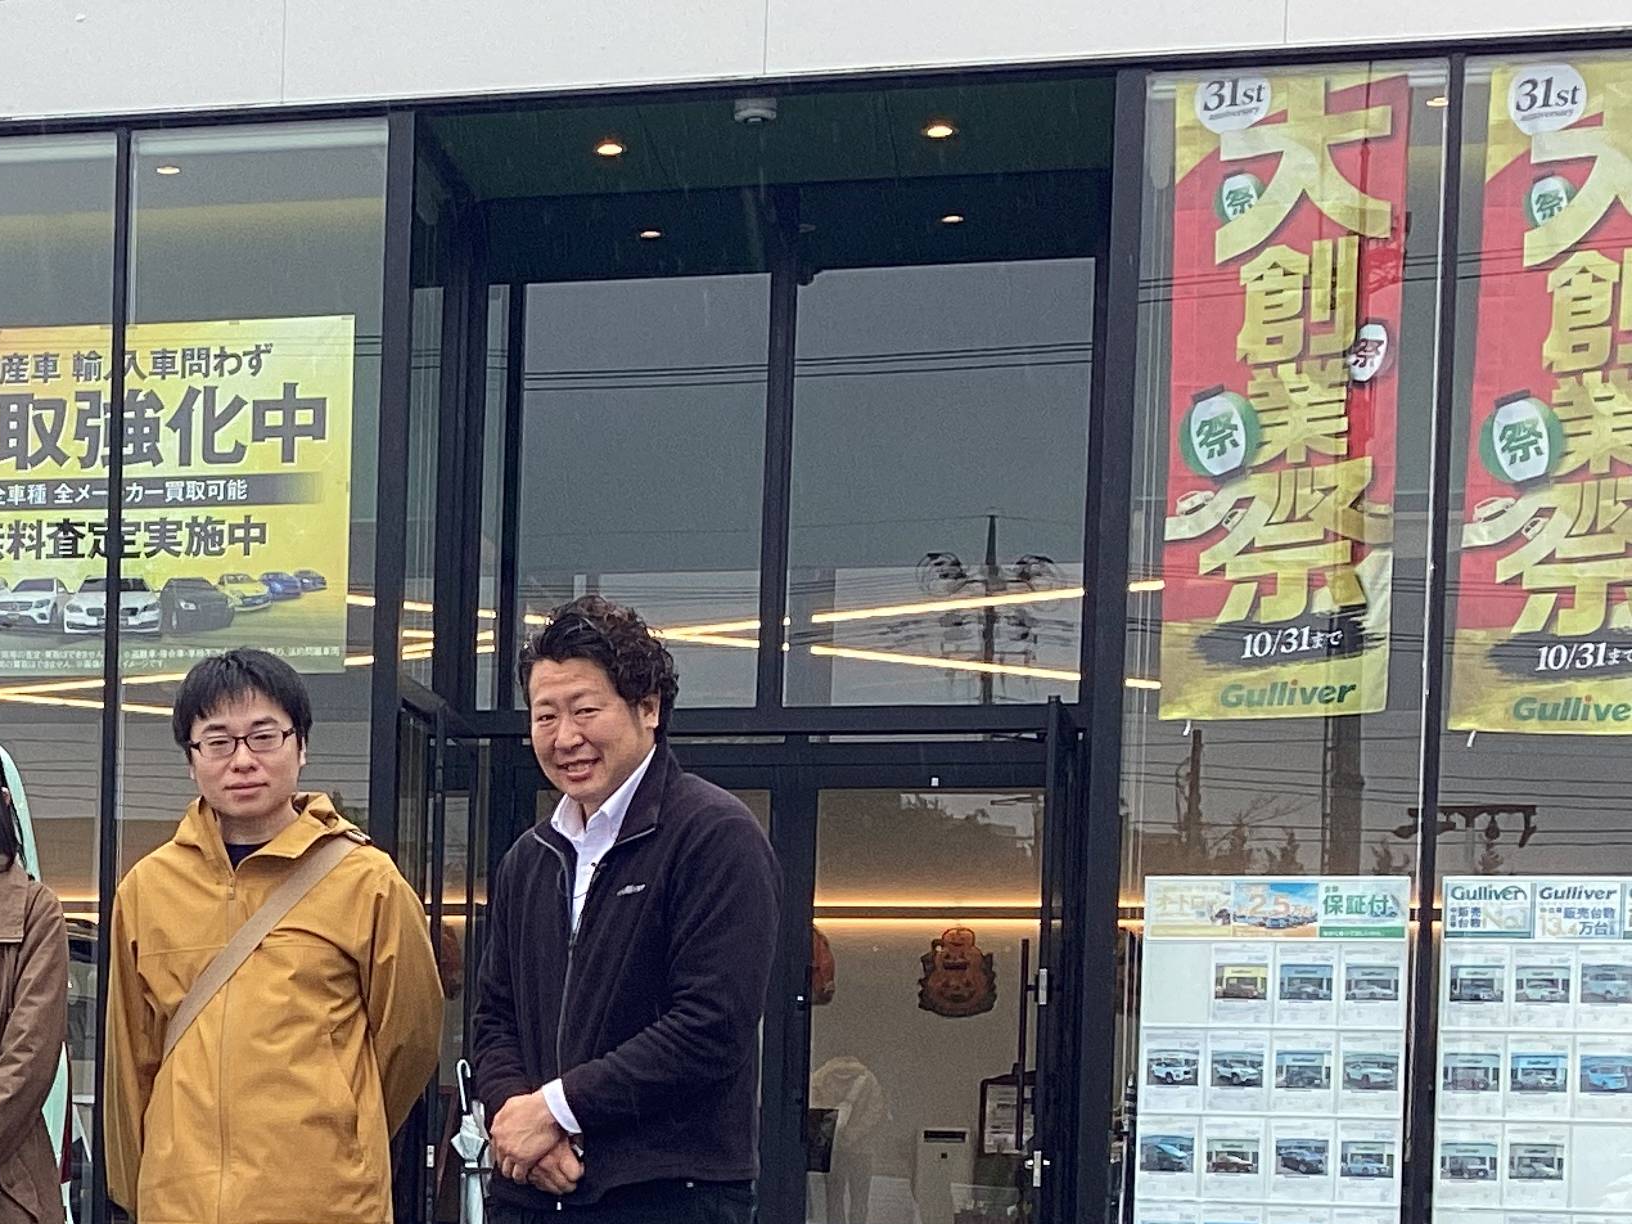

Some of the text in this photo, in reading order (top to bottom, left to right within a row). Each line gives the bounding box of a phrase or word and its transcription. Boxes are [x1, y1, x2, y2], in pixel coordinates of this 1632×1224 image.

[1203, 78, 1265, 111] 31st
[1516, 76, 1580, 112] 31st
[72, 342, 273, 384] 輸入車問わず
[1196, 410, 1239, 459] 祭
[1499, 418, 1544, 466] 祭
[53, 478, 248, 503] 全メーカー買取可能
[1240, 624, 1344, 659] 10/31まで
[1220, 679, 1357, 709] Gulliver
[1450, 884, 1528, 901] Gulliver
[1538, 885, 1618, 901] Gulliver
